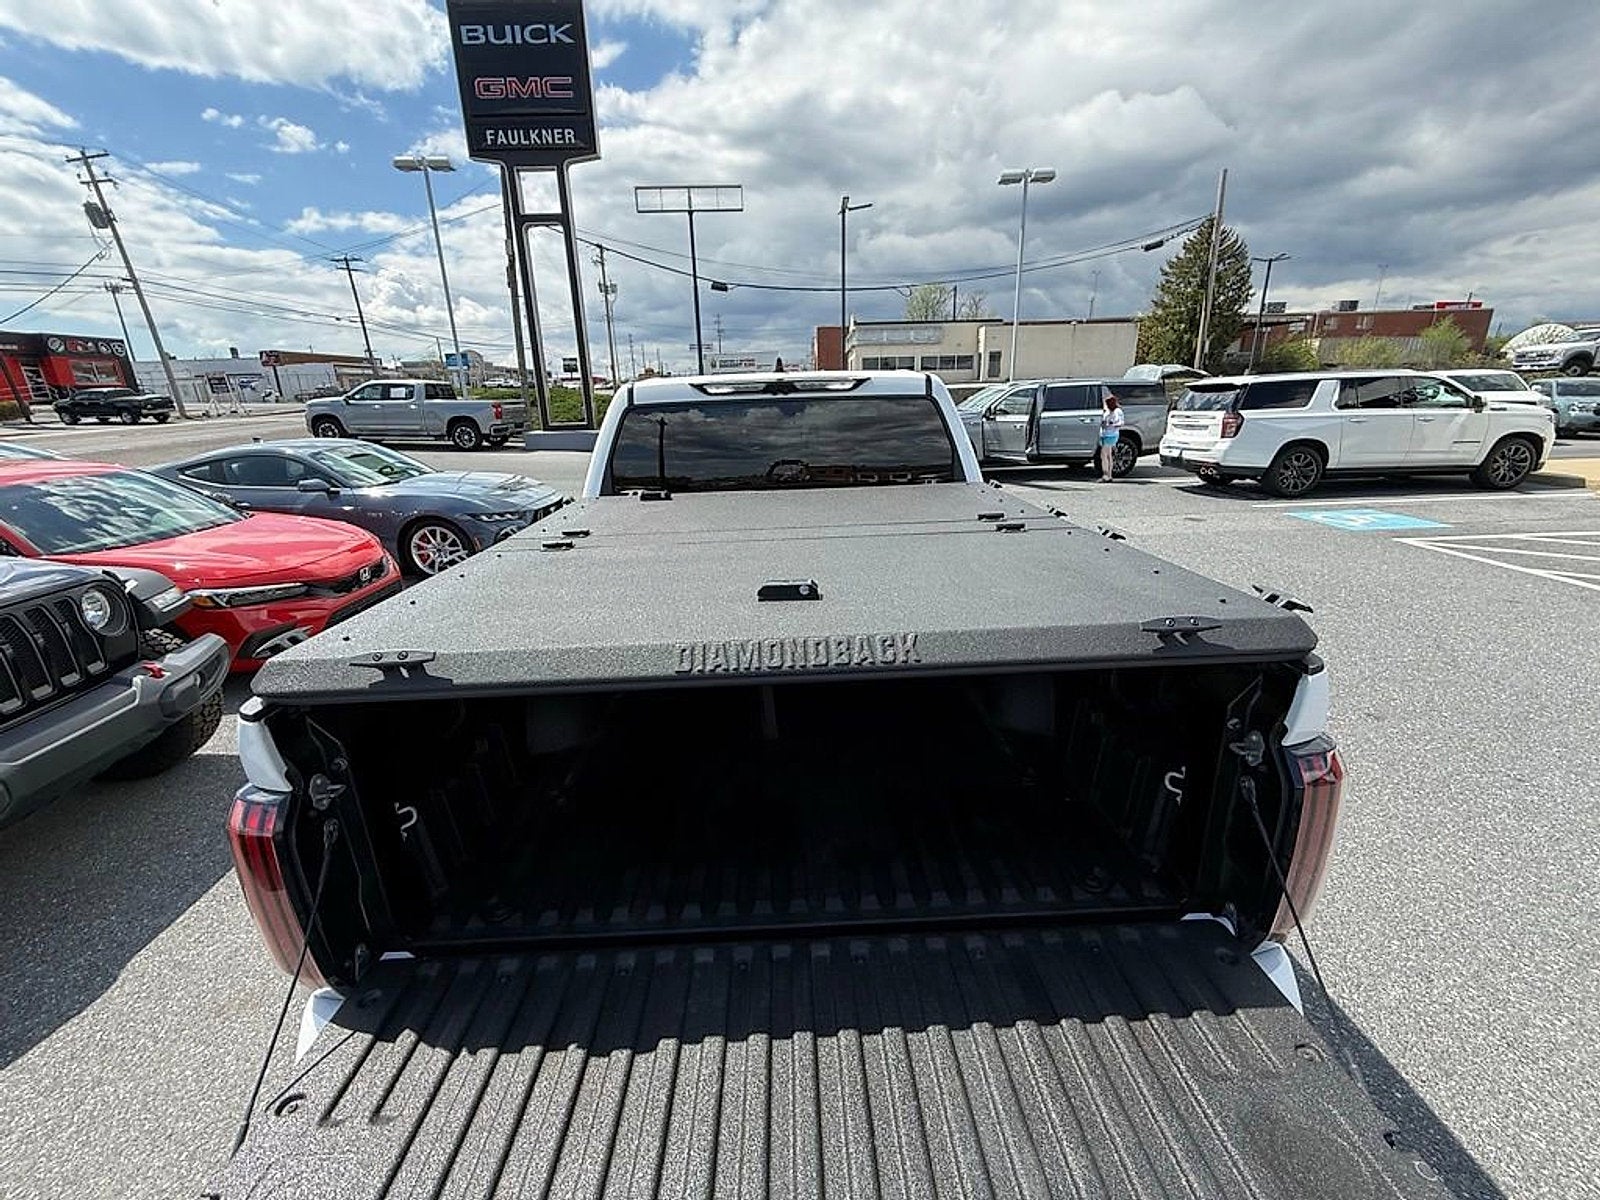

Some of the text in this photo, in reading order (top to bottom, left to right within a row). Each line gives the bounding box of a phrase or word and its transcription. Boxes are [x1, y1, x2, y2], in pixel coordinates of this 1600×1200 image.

[460, 23, 576, 45] BUICK
[475, 76, 573, 98] GMC
[486, 128, 576, 145] FAULKNER
[675, 632, 922, 674] DIAMONDBACK
